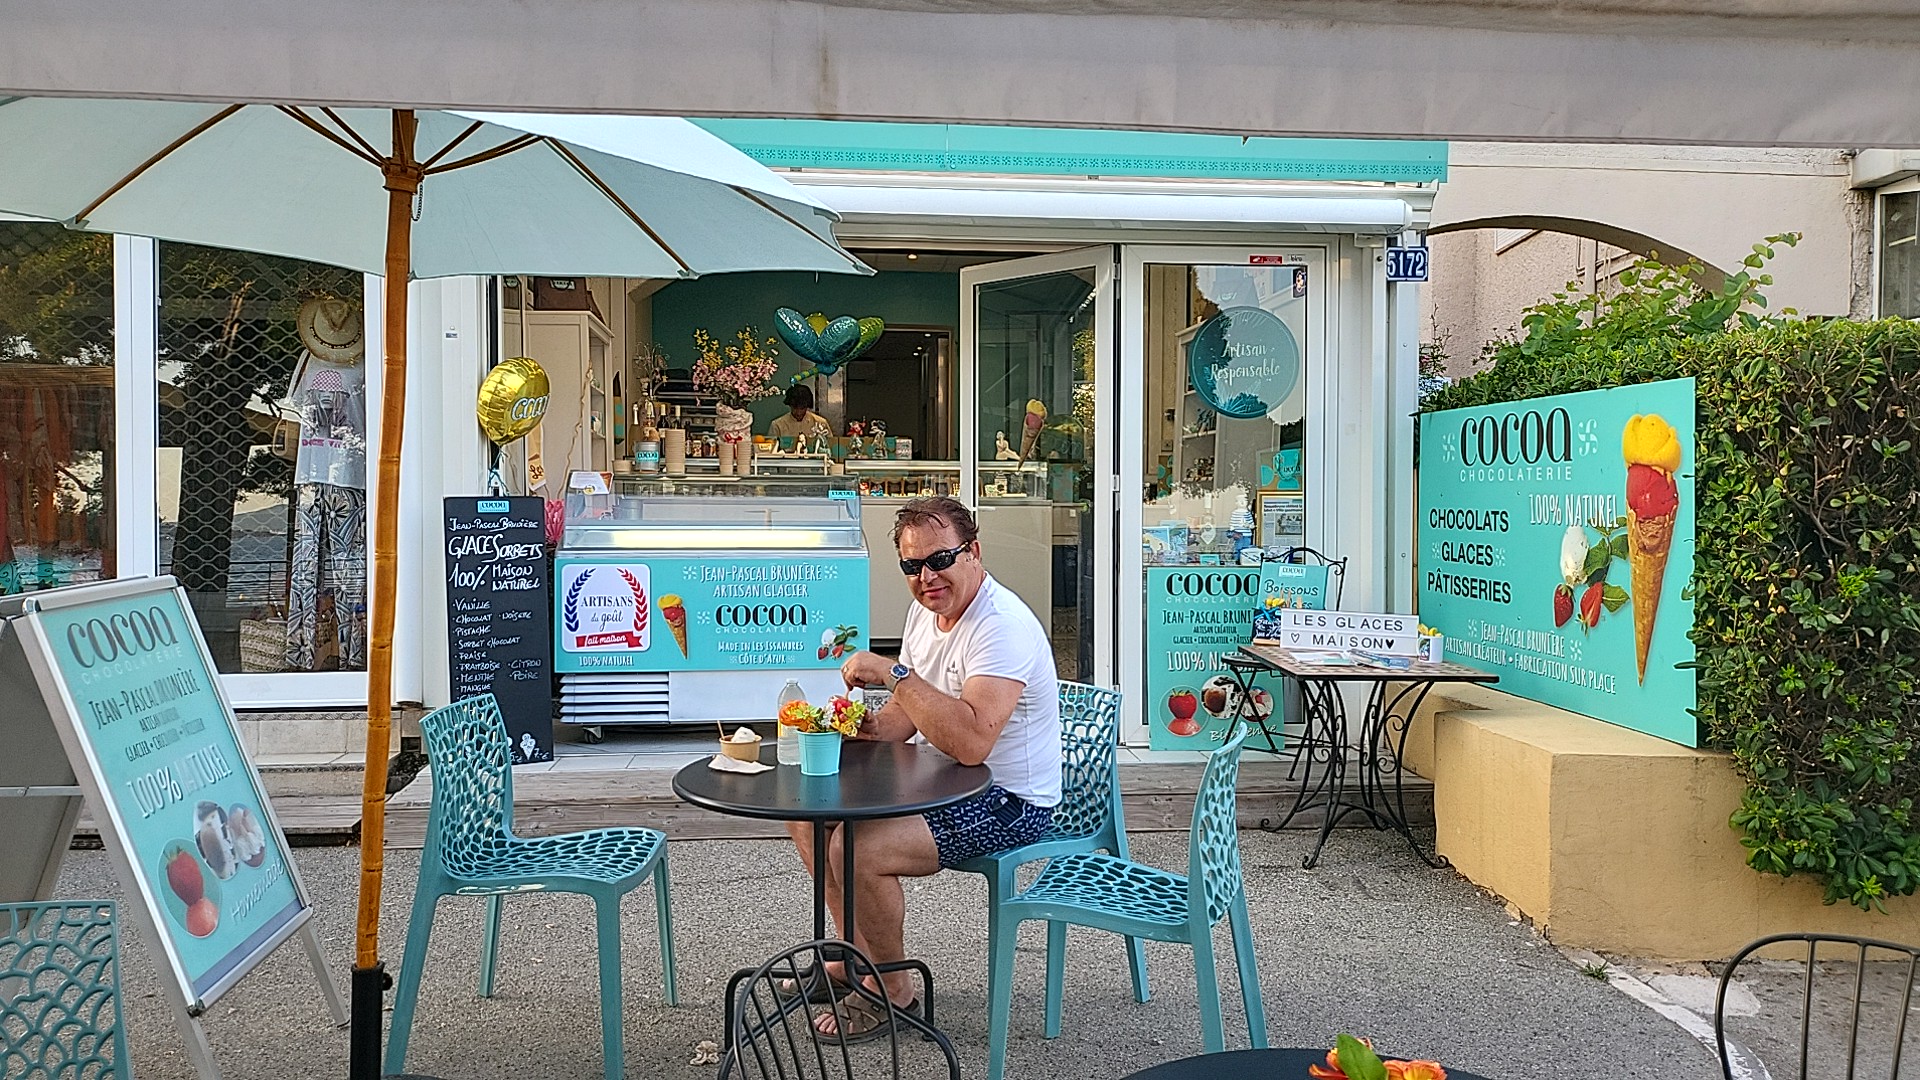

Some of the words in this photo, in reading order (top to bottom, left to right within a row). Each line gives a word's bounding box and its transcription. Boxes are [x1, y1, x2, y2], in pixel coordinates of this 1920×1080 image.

[1387, 252, 1425, 276] 5172
[1221, 341, 1268, 358] Artisan
[1209, 358, 1280, 386] Responsable
[1460, 466, 1573, 482] CHOCOLATERIE
[1429, 508, 1509, 532] CHOCOLATS
[1528, 494, 1562, 526] 100%
[1565, 493, 1620, 528] NATUREL
[1441, 541, 1494, 566] GLACES
[448, 563, 489, 590] 100%
[770, 562, 822, 581] BRUNIÈRE
[713, 584, 761, 598] ARTISAN
[763, 584, 809, 598] GLACIER
[1427, 567, 1512, 604] PÂTISSERIES
[580, 595, 634, 607] ARTISANS
[599, 609, 624, 633] goût
[1223, 609, 1252, 624] BRUNI
[1293, 614, 1327, 627] LES
[1335, 616, 1403, 631] GLACES
[715, 626, 807, 634] CHOCOLATERIE
[1312, 634, 1383, 649] MAISON
[579, 655, 600, 667] 100%
[602, 655, 634, 667] NATUREL
[1166, 651, 1205, 671] 100%
[1444, 637, 1472, 658] ARTISAN
[1473, 641, 1507, 666] CRÉATEUR
[1514, 653, 1569, 682] FABRICATION
[1570, 665, 1587, 687] SUR
[1588, 670, 1617, 695] PLACE
[511, 669, 539, 680] POIRE
[126, 766, 184, 819] 100%
